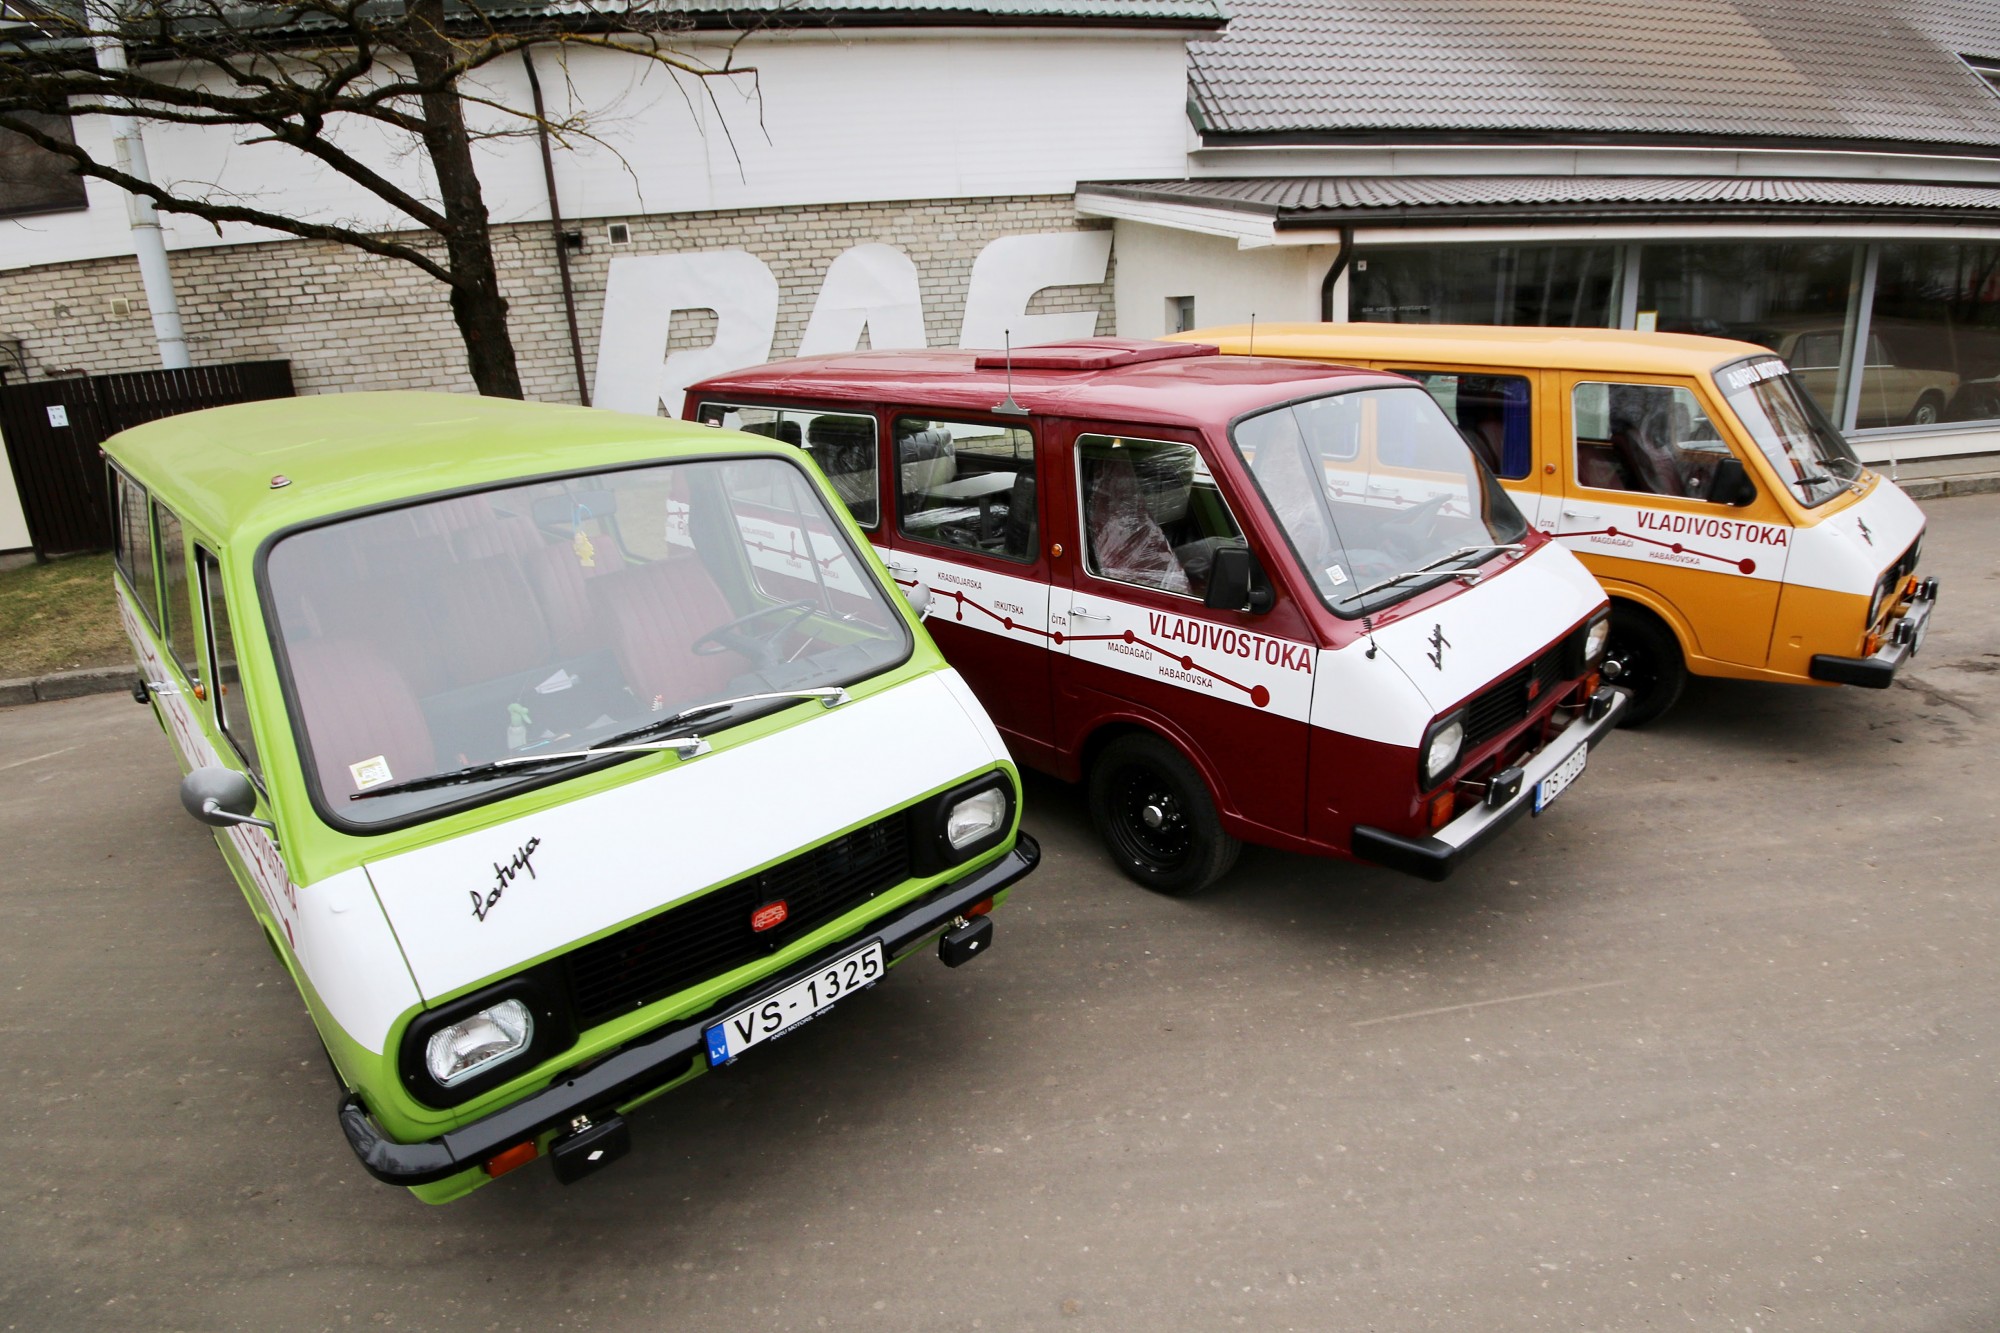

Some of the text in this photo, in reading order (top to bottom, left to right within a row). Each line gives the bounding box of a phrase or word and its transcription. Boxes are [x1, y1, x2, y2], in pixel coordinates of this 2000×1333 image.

[591, 230, 1114, 418] RAF
[1637, 511, 1787, 547] VLADIVOSTOKA
[1649, 551, 1700, 566] HABAROVSKA
[937, 571, 983, 590] KRASNOJARSKA
[993, 600, 1025, 616] IRKUTSKA
[1051, 612, 1067, 626] ČITA
[1107, 641, 1153, 661] MAGDAGAČI
[1149, 612, 1312, 675] VLADIVOSTOKA
[1158, 666, 1213, 689] HABAROVSKA
[734, 948, 878, 1044] VS-1325
[711, 1045, 726, 1059] LV
